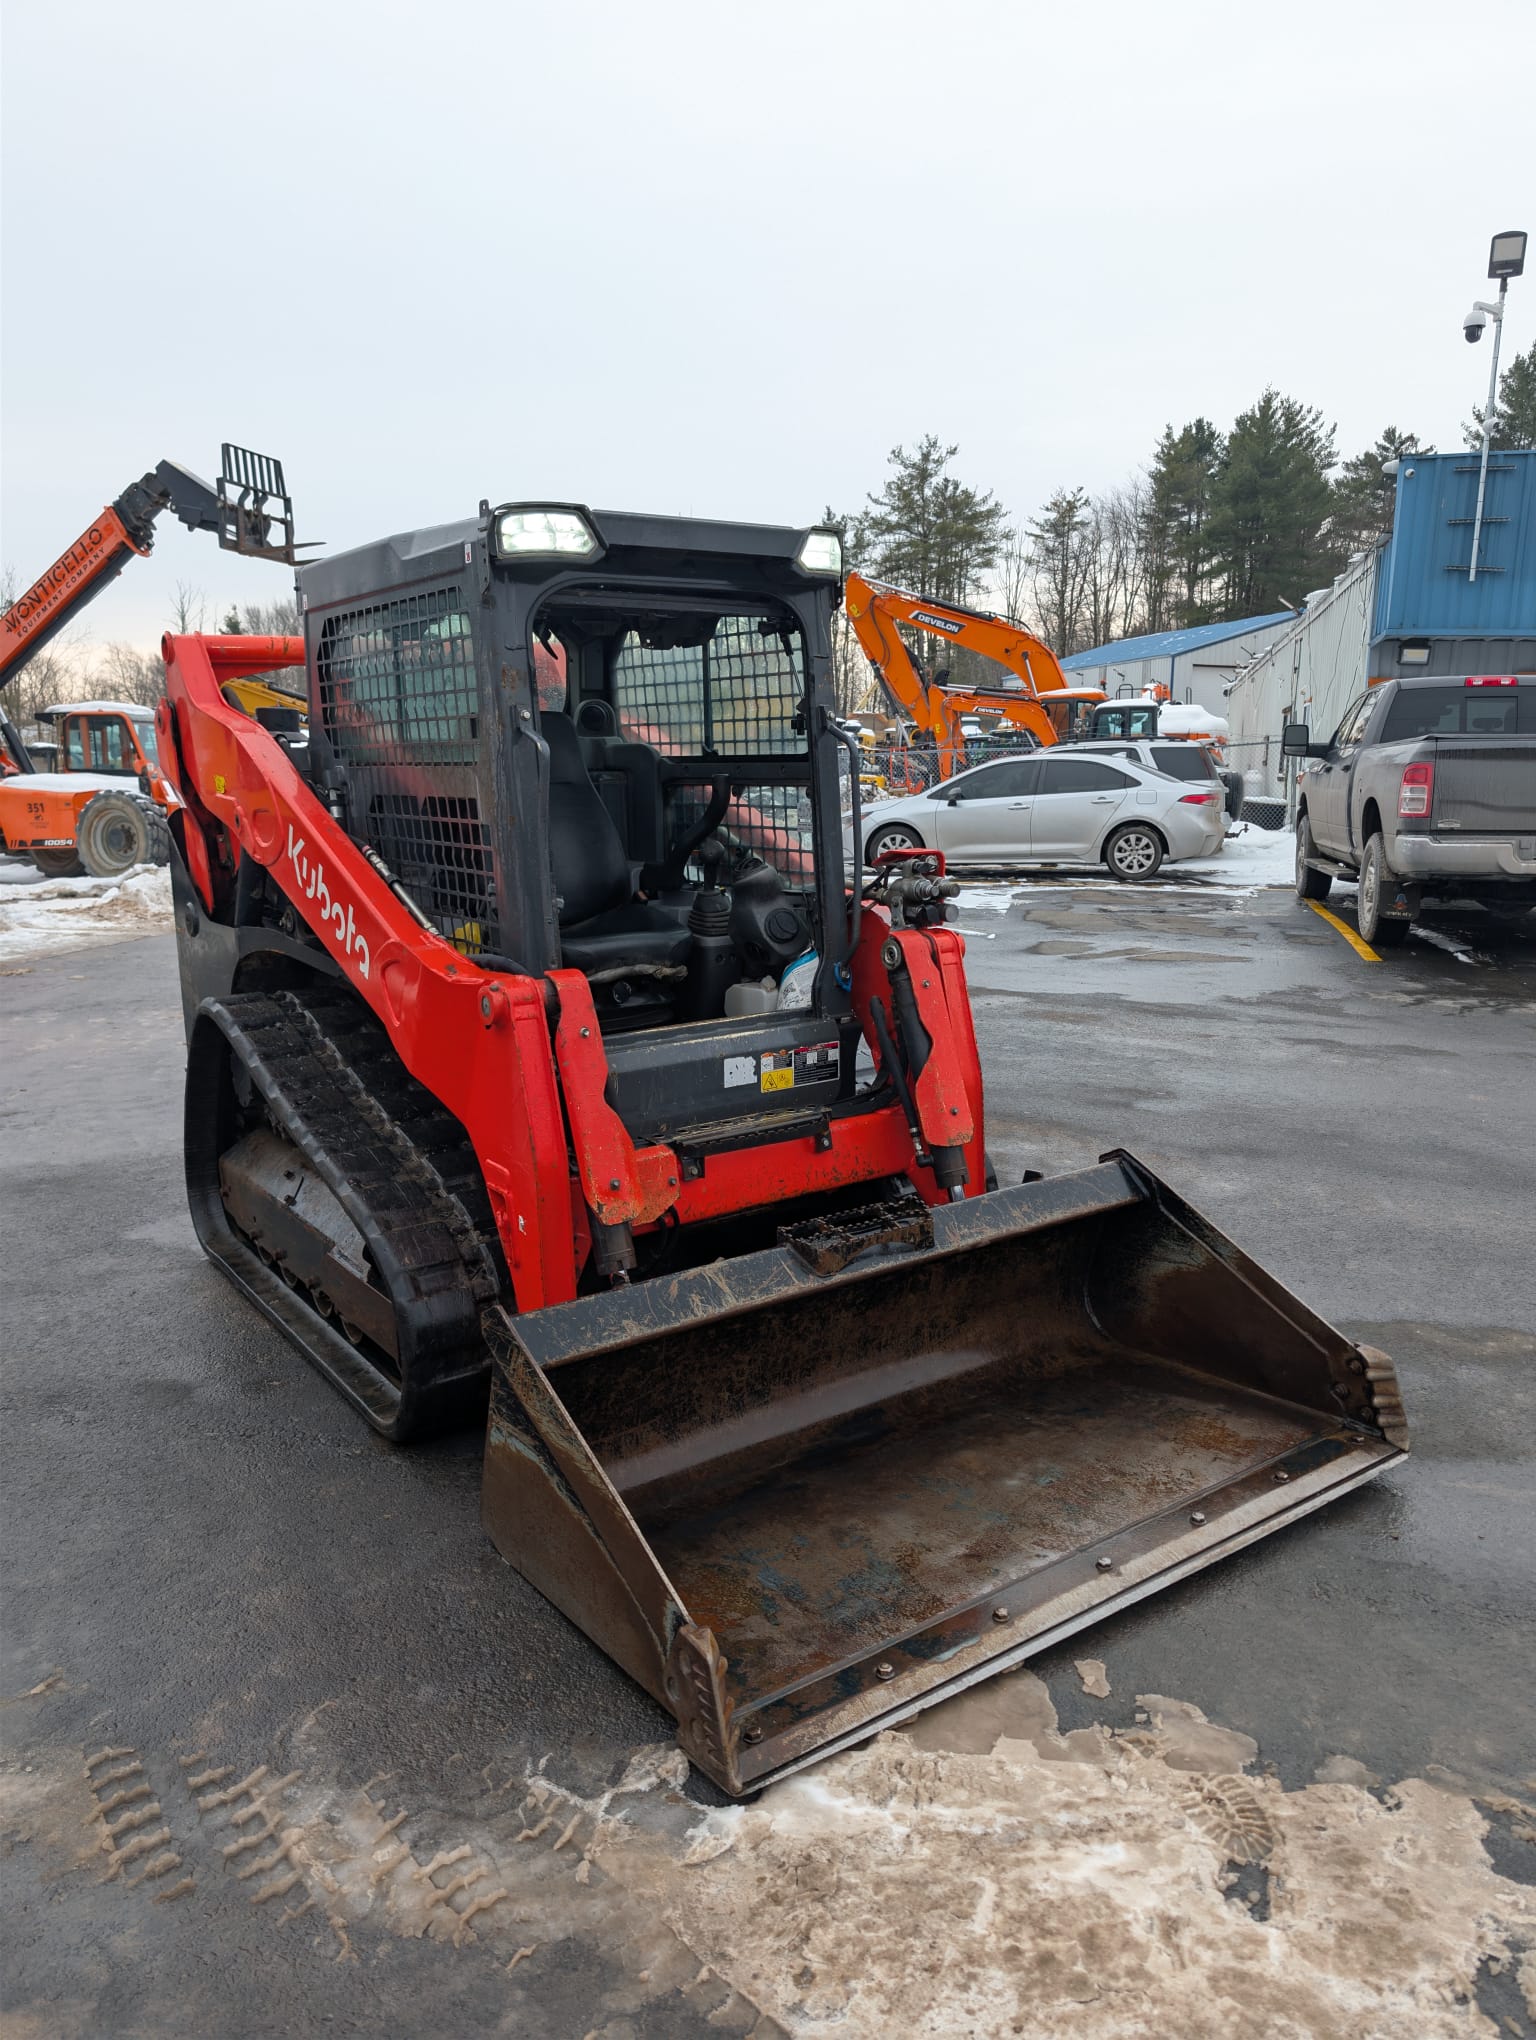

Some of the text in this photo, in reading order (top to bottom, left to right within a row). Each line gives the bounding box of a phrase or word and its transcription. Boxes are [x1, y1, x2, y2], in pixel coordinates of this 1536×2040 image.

[5, 528, 103, 632] MONTICELLO
[17, 547, 105, 638] EQUIPMENT COMPANY
[918, 614, 959, 633] DEVELON
[27, 802, 45, 813] 351
[288, 824, 370, 980] Kubota
